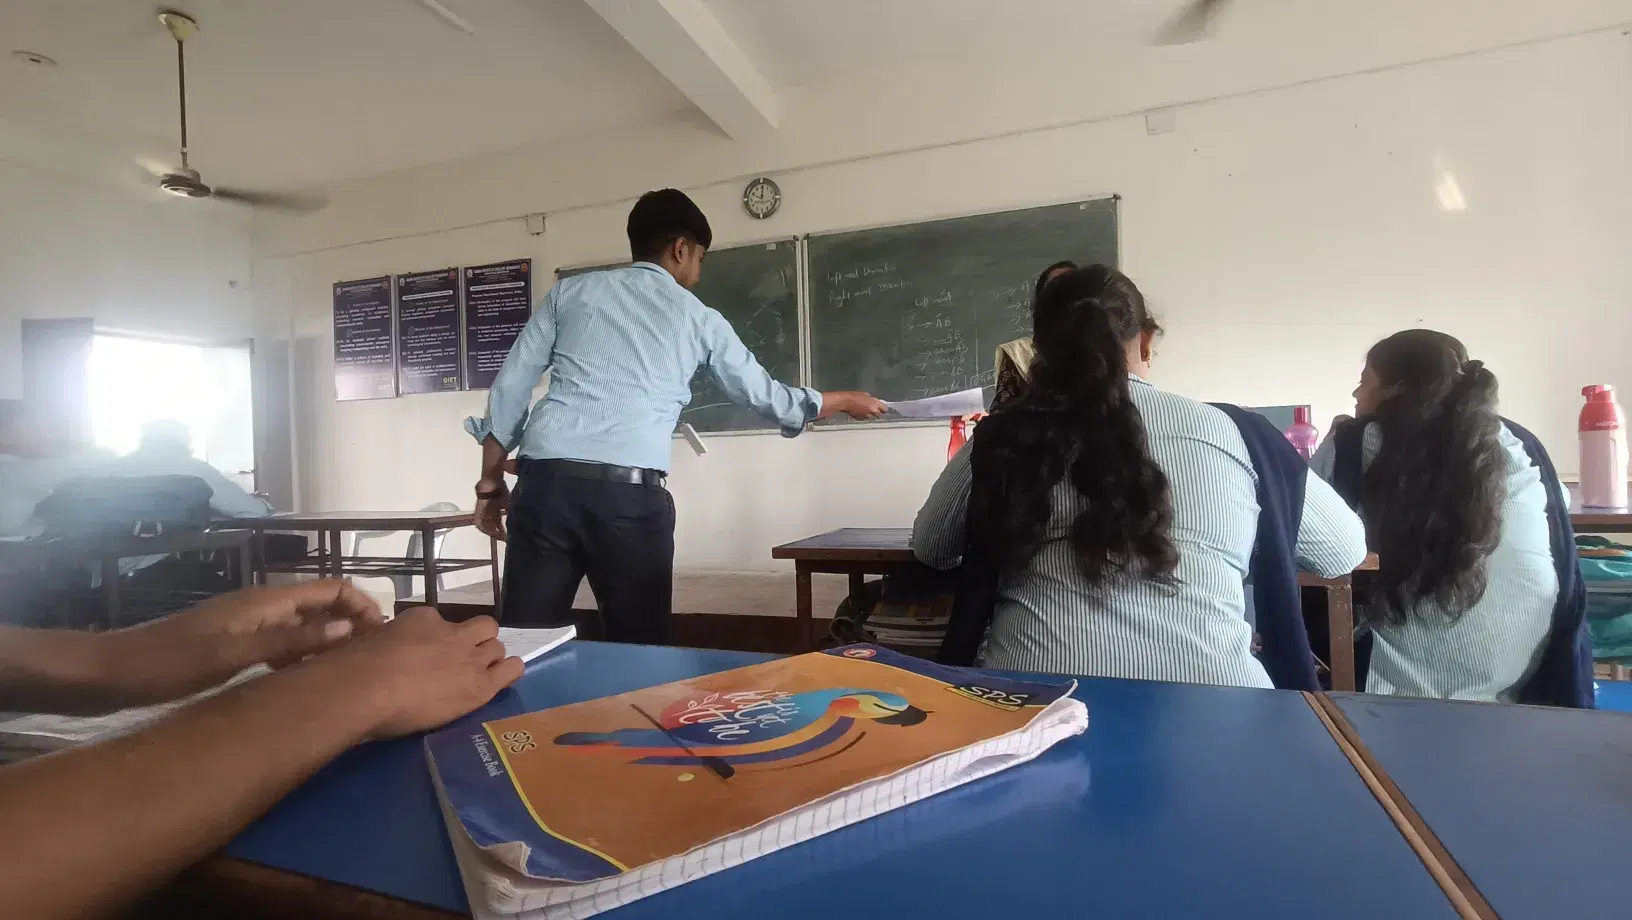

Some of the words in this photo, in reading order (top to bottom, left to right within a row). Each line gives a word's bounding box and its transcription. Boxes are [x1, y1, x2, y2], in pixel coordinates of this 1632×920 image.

[959, 686, 1029, 706] SPS
[501, 730, 537, 754] SPS
[484, 760, 504, 777] Book
